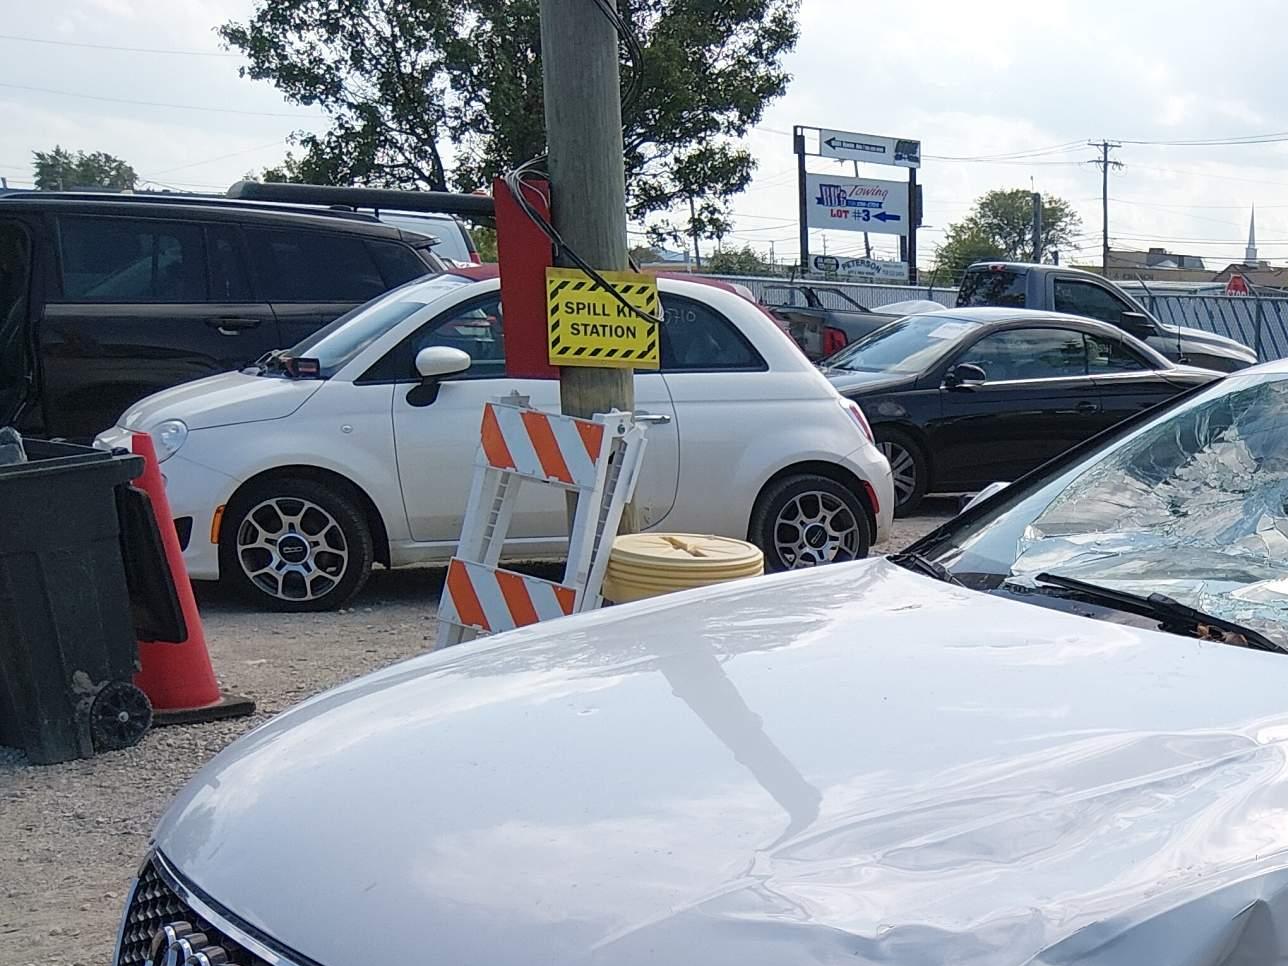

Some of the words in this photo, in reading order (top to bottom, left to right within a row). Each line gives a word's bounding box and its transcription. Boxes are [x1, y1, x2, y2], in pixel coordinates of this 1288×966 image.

[843, 184, 888, 201] Towing
[830, 208, 850, 219] LOT
[852, 209, 870, 221] #3
[841, 259, 881, 274] PETERSON
[564, 301, 610, 317] SPILL
[570, 322, 637, 339] STATION
